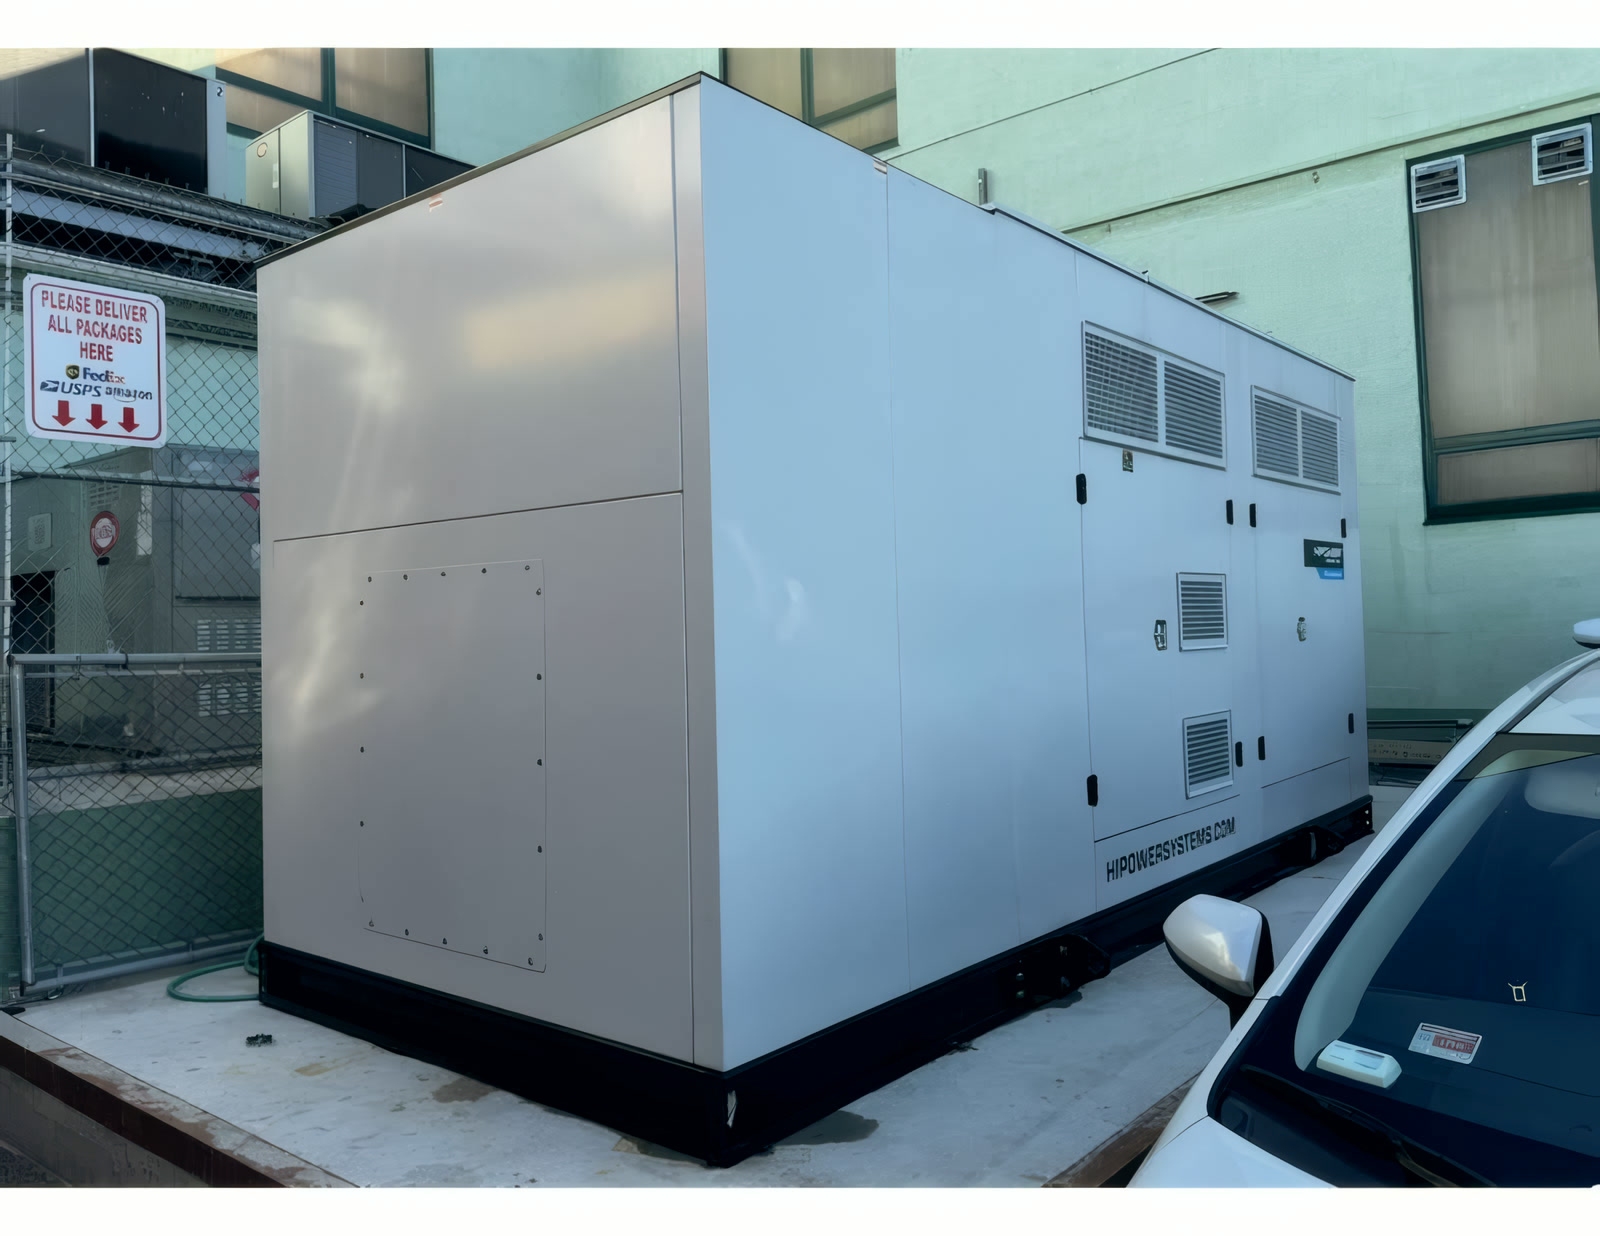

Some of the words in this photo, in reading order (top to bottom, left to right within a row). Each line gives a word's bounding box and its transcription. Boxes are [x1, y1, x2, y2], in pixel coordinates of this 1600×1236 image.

[41, 290, 91, 315] PLEASE
[95, 299, 147, 323] DELIVER
[47, 314, 72, 334] ALL
[76, 318, 142, 344] PACKAGES
[80, 341, 113, 362] HERE
[61, 381, 102, 398] USPS
